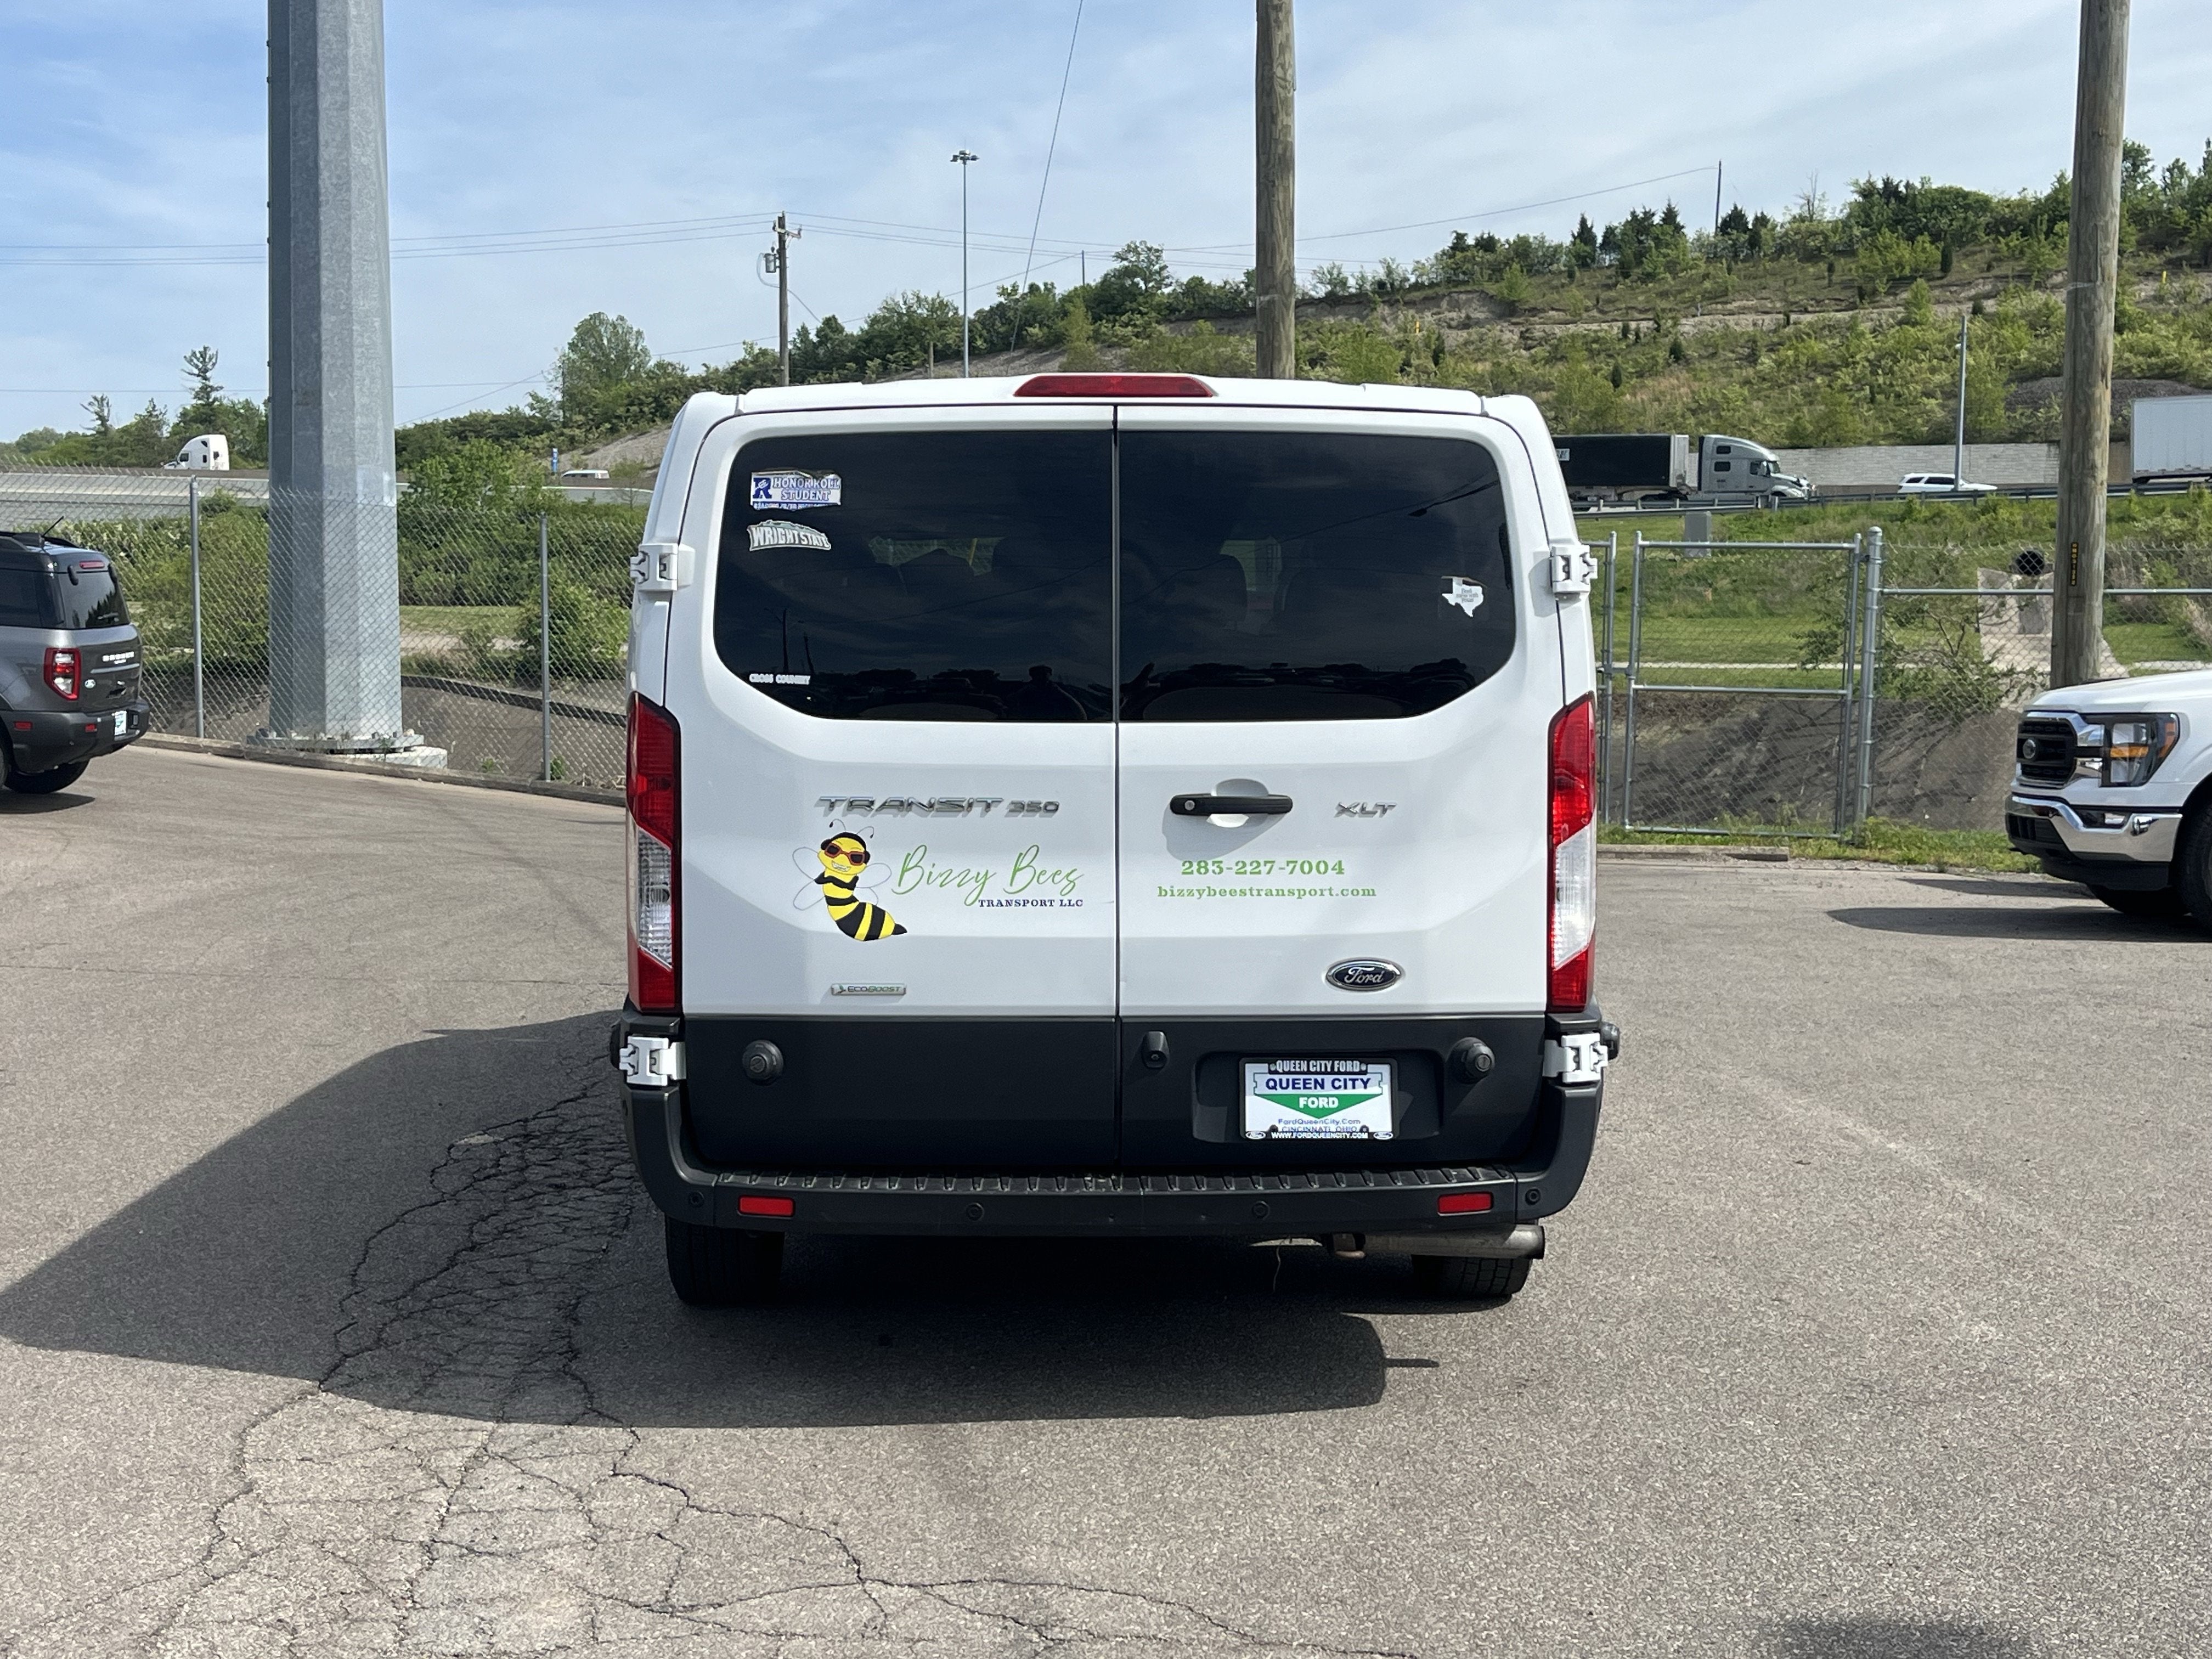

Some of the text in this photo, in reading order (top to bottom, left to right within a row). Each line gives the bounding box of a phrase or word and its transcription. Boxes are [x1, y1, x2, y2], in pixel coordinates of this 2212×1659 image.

[772, 477, 811, 489] HONOR
[781, 490, 830, 501] STUDENT
[752, 527, 798, 548] WRIGHT
[817, 795, 1059, 813] TRANSIT 350
[1336, 802, 1397, 814] XLT
[1181, 860, 1345, 876] 283-227-7004
[891, 844, 1085, 906] Bizzy Bees
[1157, 886, 1377, 900] bizzybeestransport.com
[978, 899, 1084, 907] TRANSPORT LLC
[1344, 967, 1385, 984] Ford
[1276, 1060, 1361, 1073] QUEEN CITY FORD
[1265, 1078, 1371, 1091] QUEEN CITY
[1299, 1097, 1339, 1109] FORD
